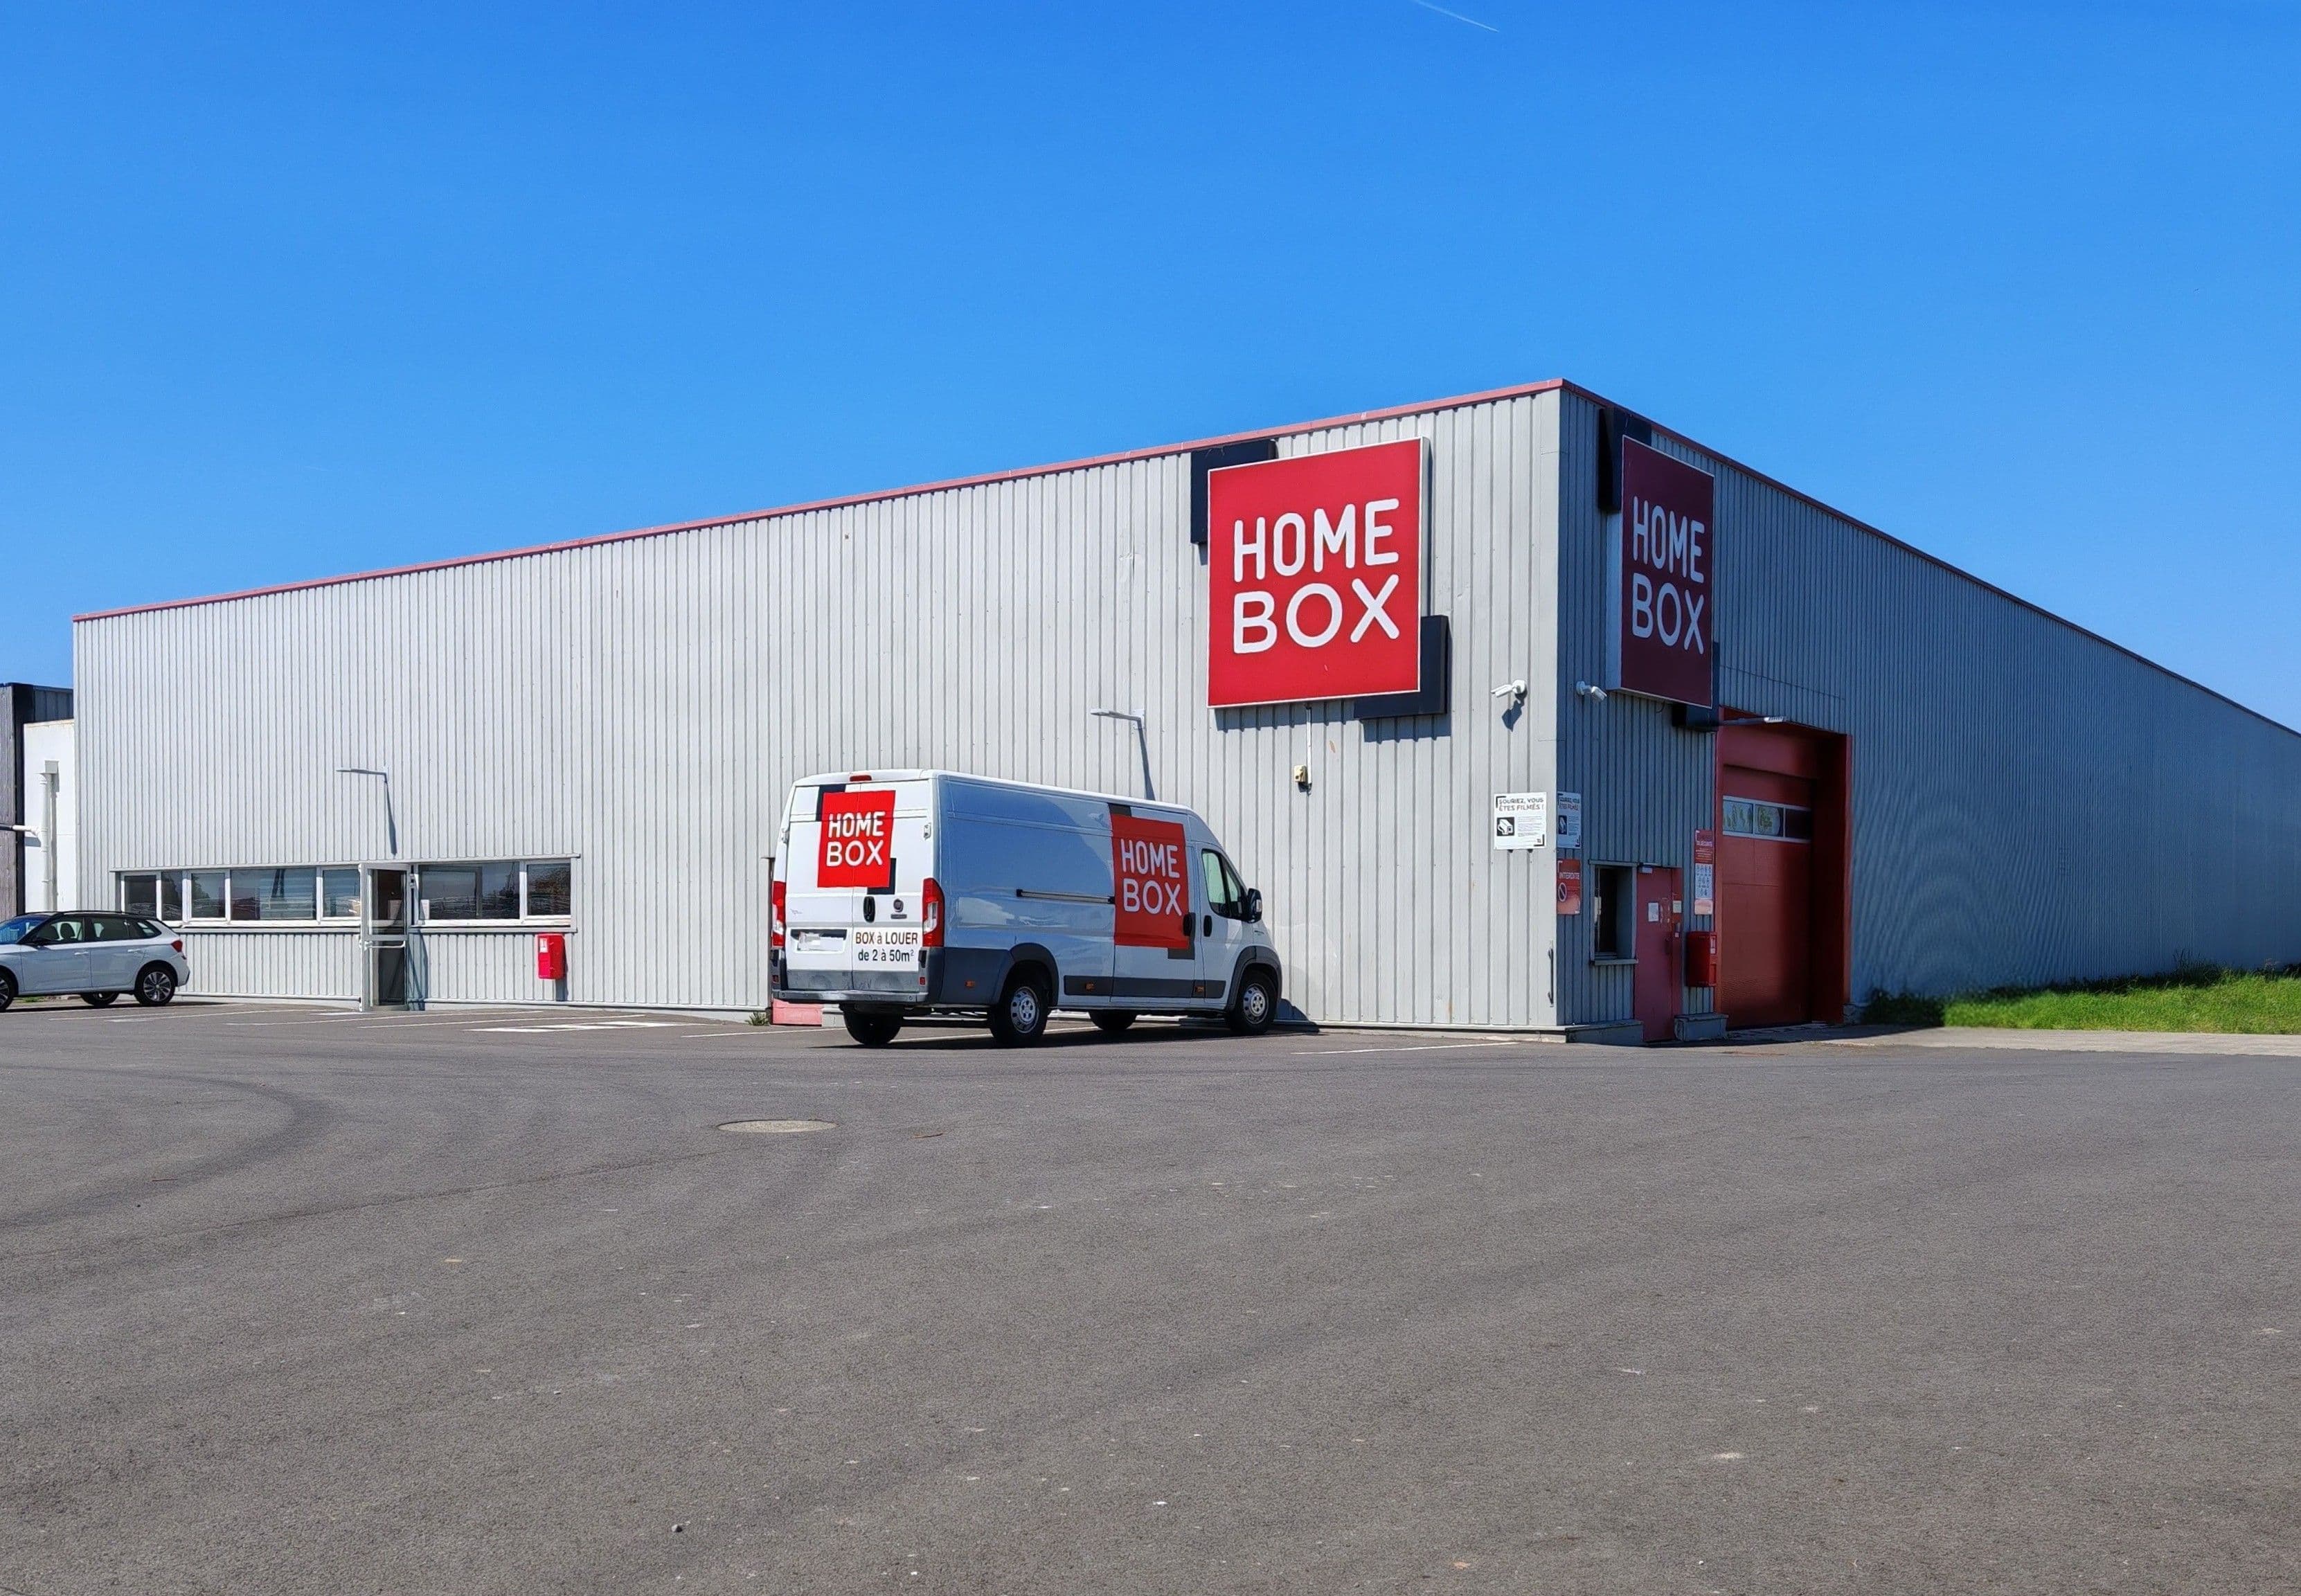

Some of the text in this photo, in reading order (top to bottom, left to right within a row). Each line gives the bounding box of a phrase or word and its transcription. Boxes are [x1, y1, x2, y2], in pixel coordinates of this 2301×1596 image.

[1233, 498, 1399, 582] HOME
[1633, 496, 1705, 583] HOME
[1233, 574, 1400, 654] BOX
[1632, 573, 1704, 654] BOX
[827, 811, 886, 839] HOME
[825, 839, 884, 867] BOX
[1120, 839, 1180, 879] HOME
[1122, 878, 1183, 917] BOX
[855, 932, 918, 945] BOX à LOUER
[858, 949, 869, 961] de
[872, 949, 878, 961] 2
[881, 948, 886, 962] à
